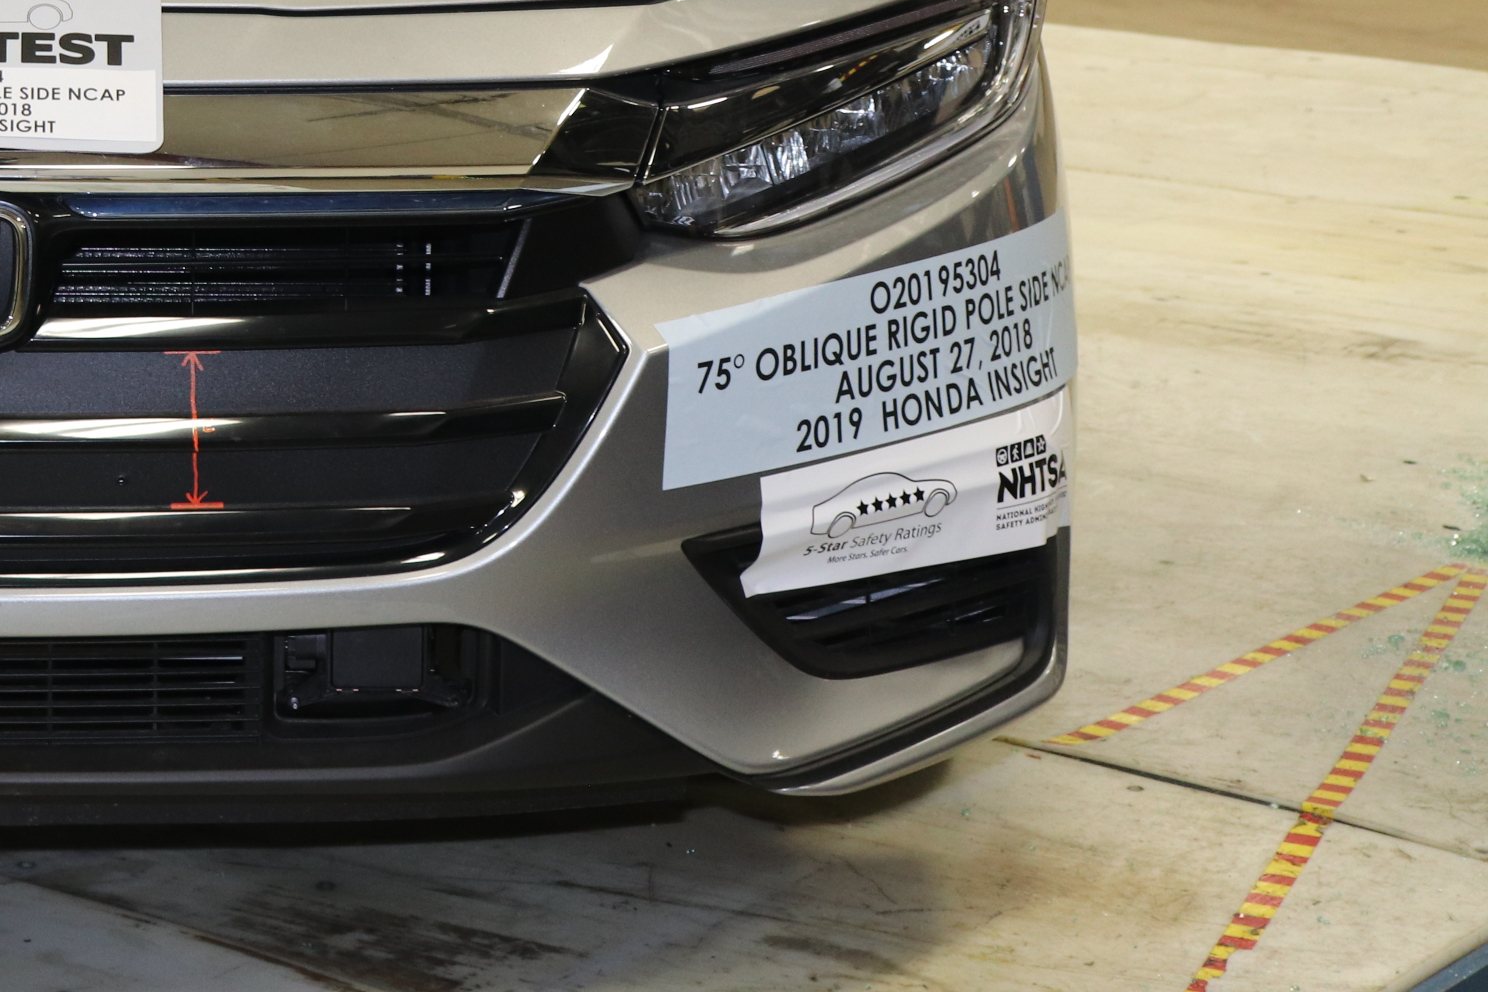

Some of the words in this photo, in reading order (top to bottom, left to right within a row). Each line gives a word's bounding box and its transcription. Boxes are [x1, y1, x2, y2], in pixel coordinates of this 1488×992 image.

[19, 86, 61, 100] SIDE
[68, 87, 126, 101] NCAP
[755, 323, 878, 381] OBLIQUE
[887, 305, 957, 351] RIGID
[965, 285, 1015, 330] POLE
[1019, 271, 1049, 312] SIDE
[834, 347, 940, 404] AUGUST
[949, 336, 983, 374] 27,
[990, 318, 1033, 362] 2018
[796, 407, 863, 453] 2019
[881, 377, 984, 432] HONDA
[988, 347, 1058, 402] INSIGHT
[997, 449, 1067, 503] NHTSA
[996, 507, 1033, 521] NATIONAL
[996, 519, 1023, 530] SAFETY
[803, 540, 848, 556] 5-Star
[850, 533, 893, 549] Safety
[894, 522, 942, 541] Ratings
[827, 553, 847, 563] More
[848, 551, 868, 561] Stars.
[870, 548, 890, 558] Safer
[891, 546, 908, 555] Cars.
